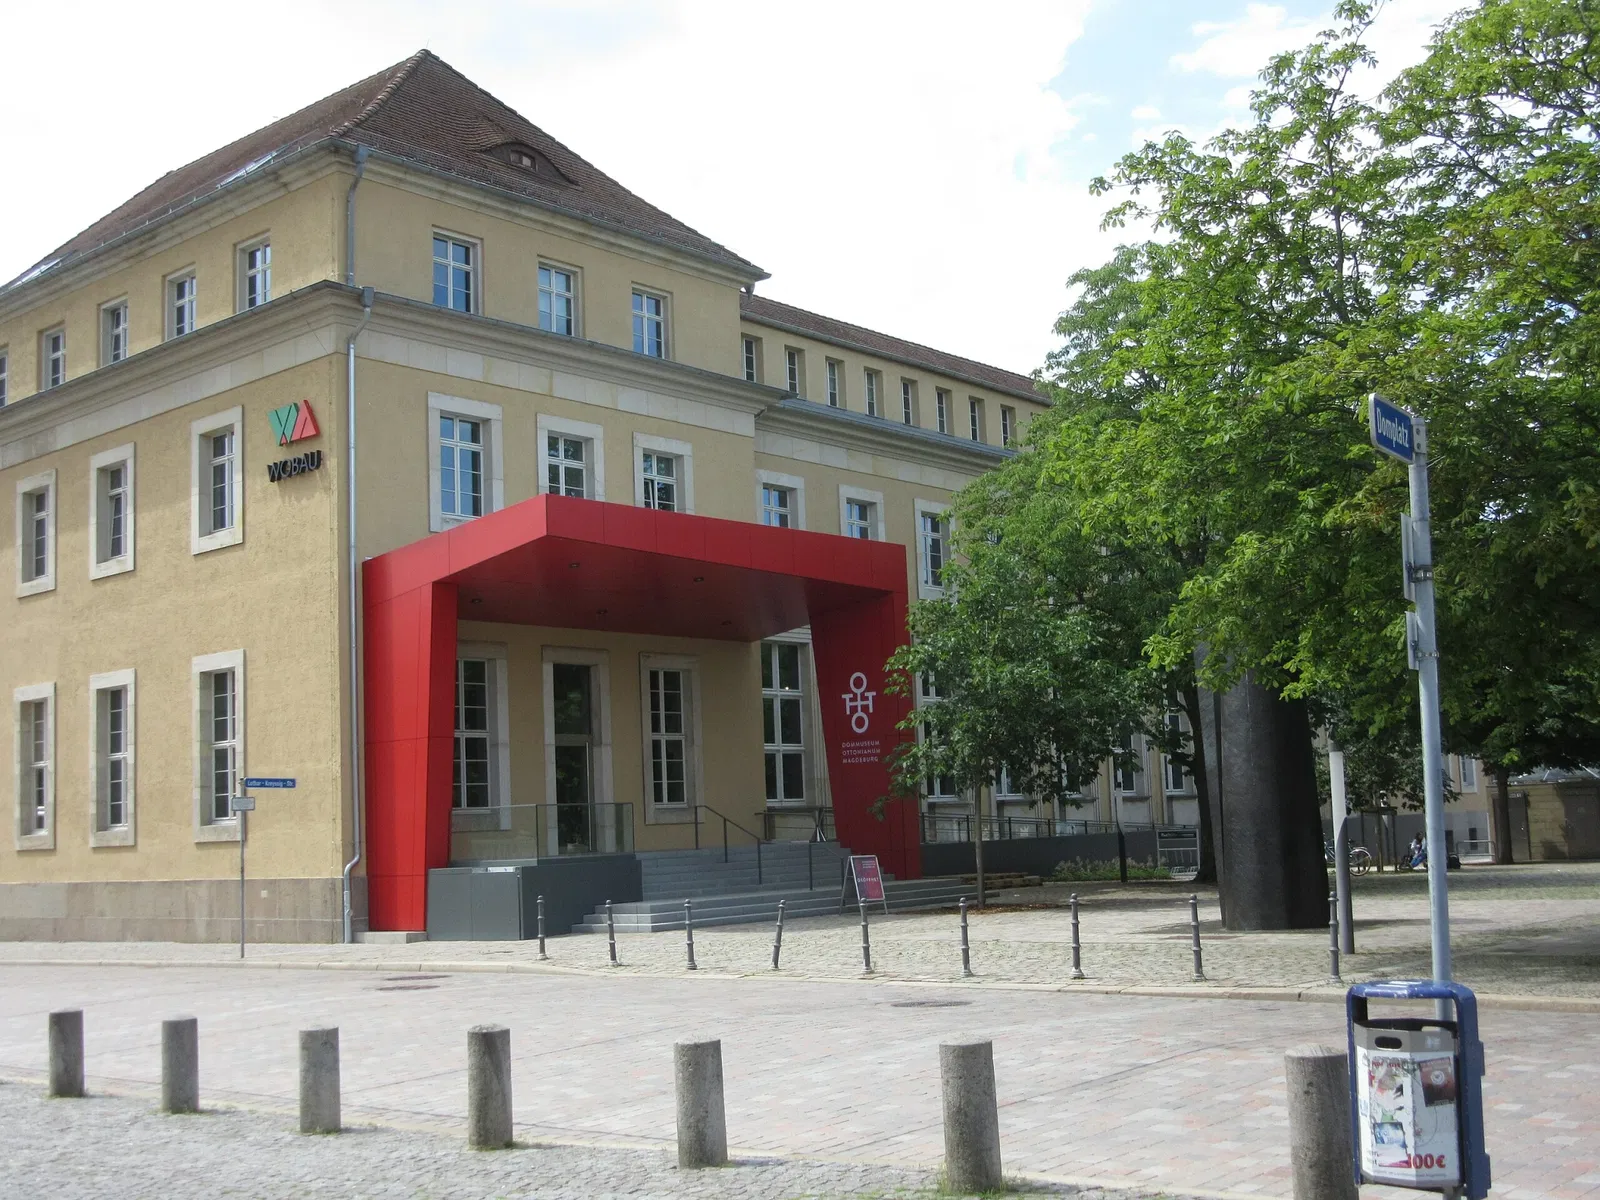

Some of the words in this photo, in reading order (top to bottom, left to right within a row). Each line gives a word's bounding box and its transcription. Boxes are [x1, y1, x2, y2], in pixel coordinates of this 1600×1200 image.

[1376, 407, 1409, 448] Domplatz
[267, 449, 322, 483] WOBAU
[841, 740, 880, 748] DOMMUSEUM
[842, 748, 881, 756] OTTONIANUM
[842, 756, 879, 764] MAGDEBURG
